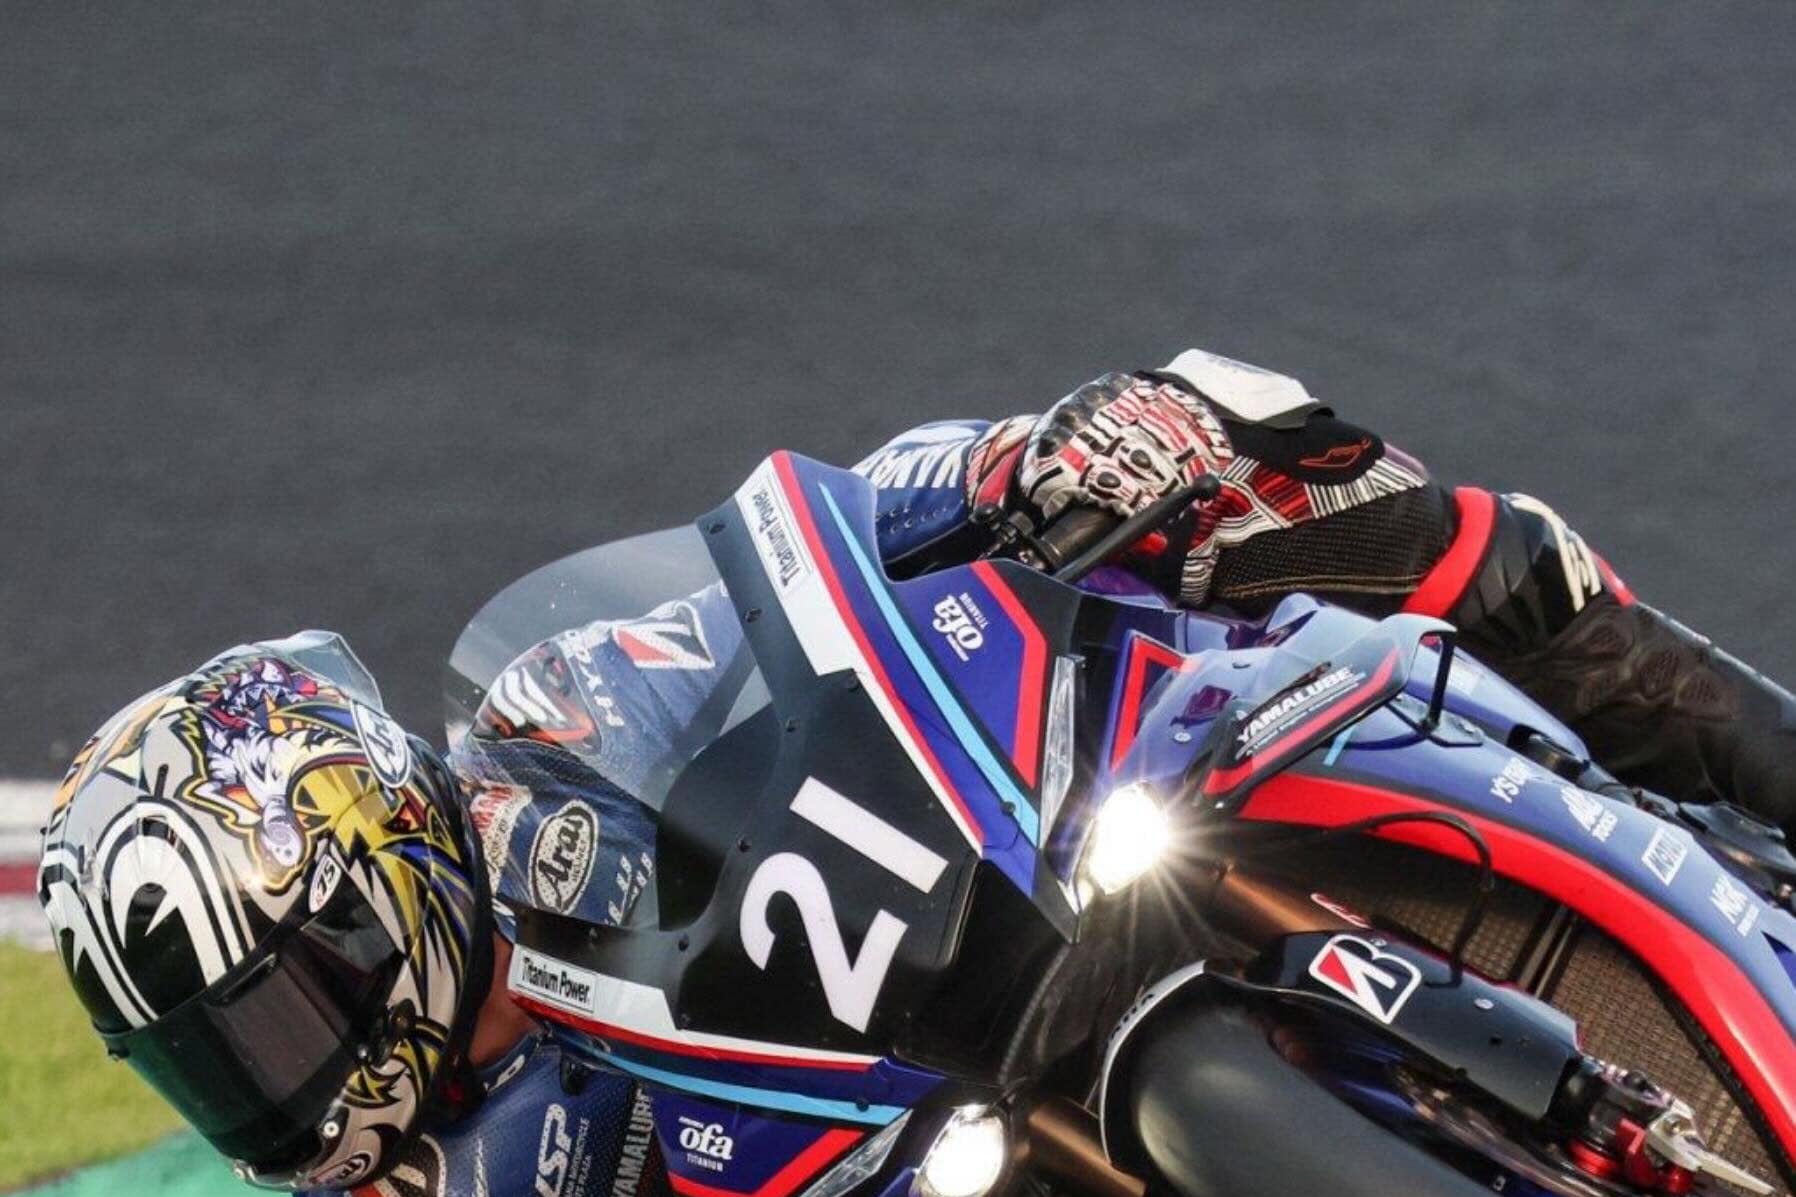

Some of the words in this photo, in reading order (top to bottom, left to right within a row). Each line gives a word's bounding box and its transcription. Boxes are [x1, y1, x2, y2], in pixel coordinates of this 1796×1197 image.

[767, 522, 801, 588] Titanium
[1237, 666, 1356, 743] YAMALUBE
[739, 775, 949, 1034] 21
[522, 956, 559, 994] Titanium
